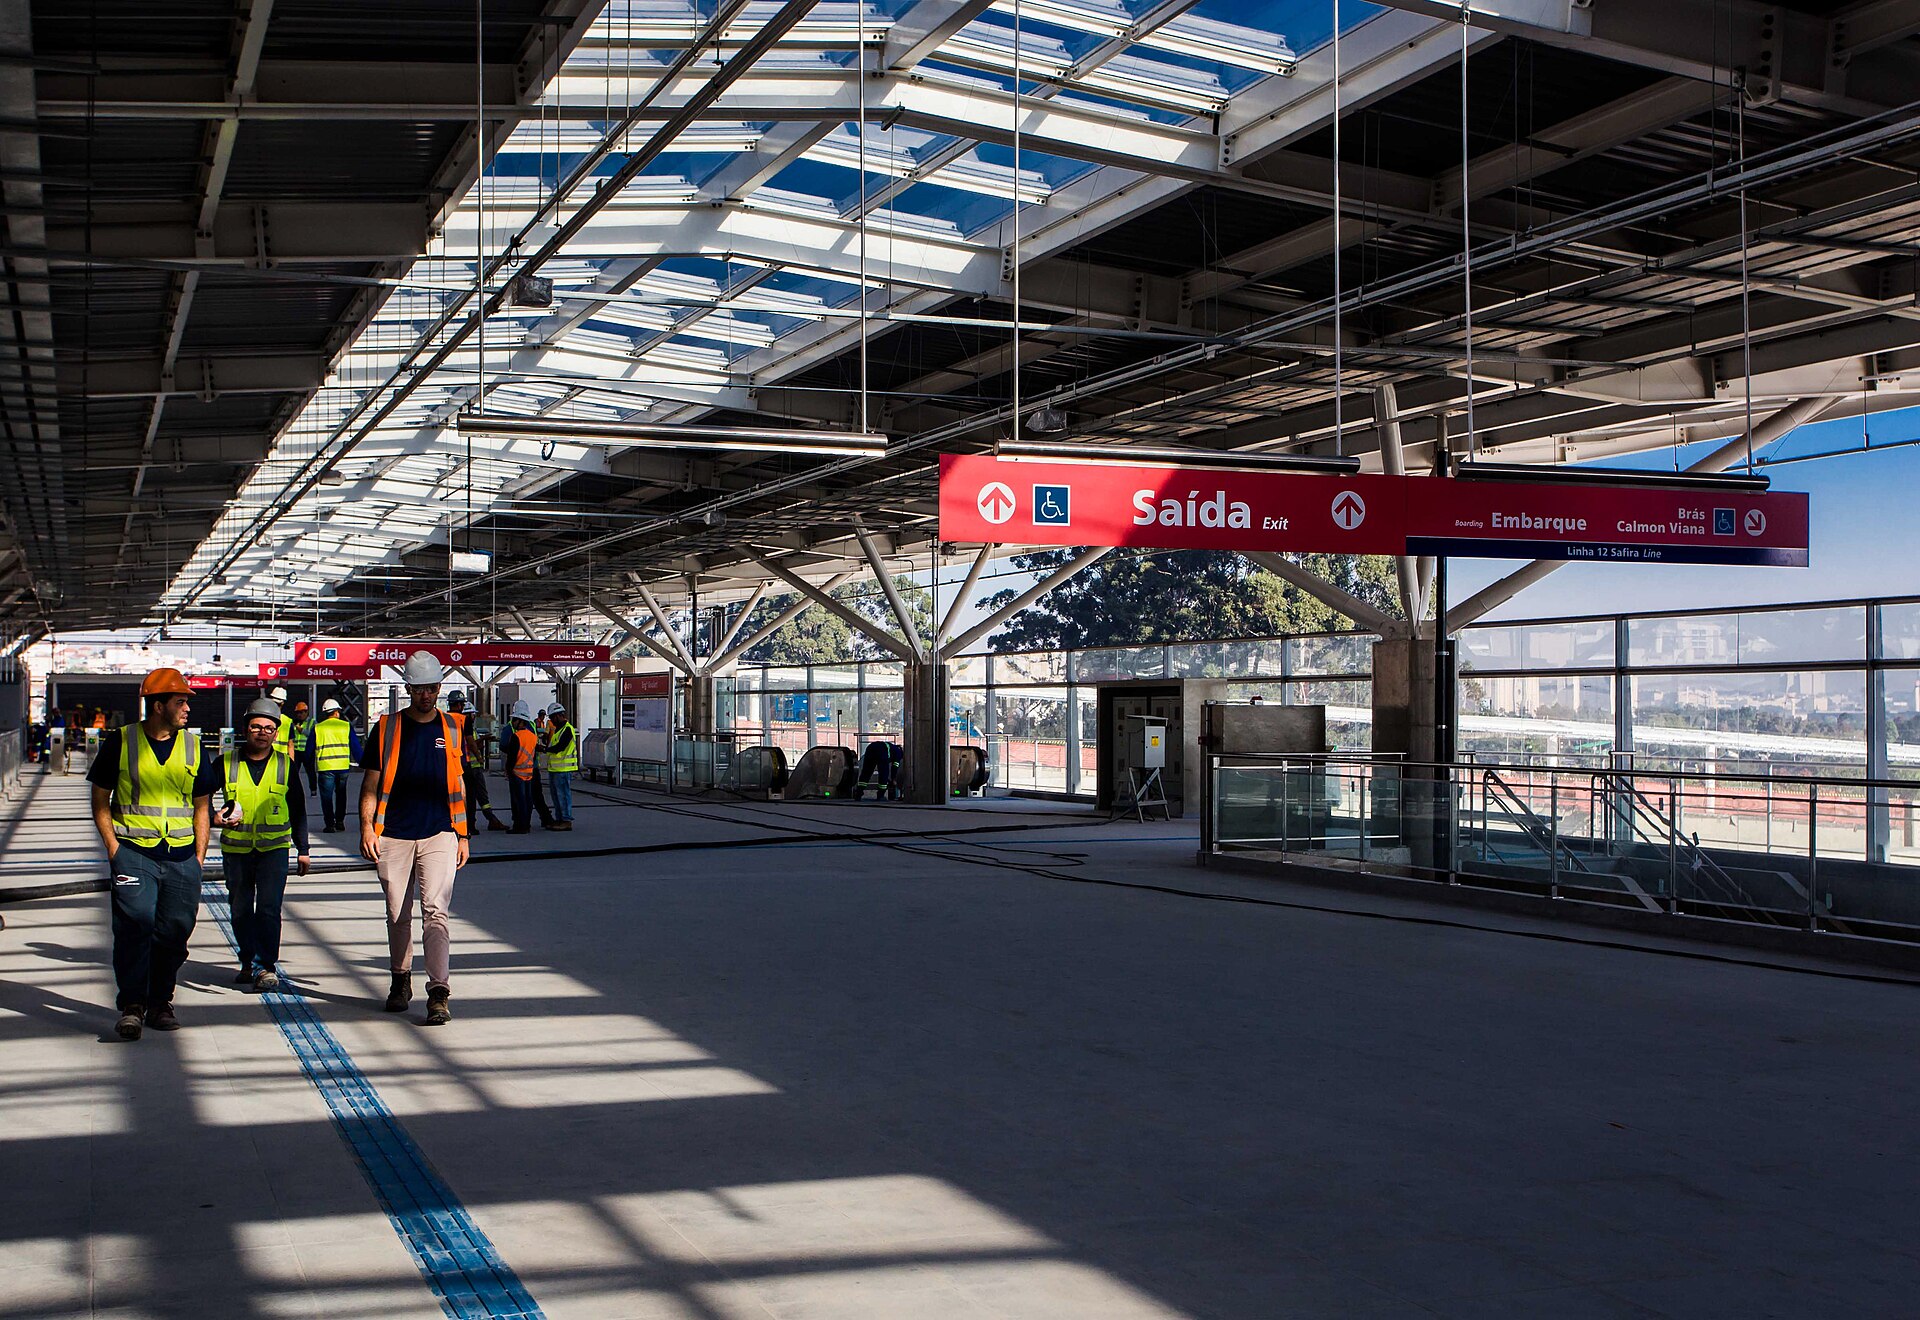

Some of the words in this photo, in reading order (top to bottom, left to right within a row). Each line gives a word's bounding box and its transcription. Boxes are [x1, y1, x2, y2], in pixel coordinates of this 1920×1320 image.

[1132, 489, 1251, 529] Saída
[1262, 516, 1289, 531] Exit
[1678, 508, 1705, 521] Brás
[1455, 519, 1484, 529] Boarding
[1491, 512, 1588, 534] Embarque
[1616, 520, 1667, 535] Calmon
[1669, 521, 1705, 536] Viana
[1567, 546, 1594, 557] Linha
[1597, 547, 1608, 557] 12
[1611, 547, 1639, 559] Safira
[1643, 548, 1662, 559] Line
[368, 649, 407, 660] Saída
[307, 667, 334, 676] Saída
